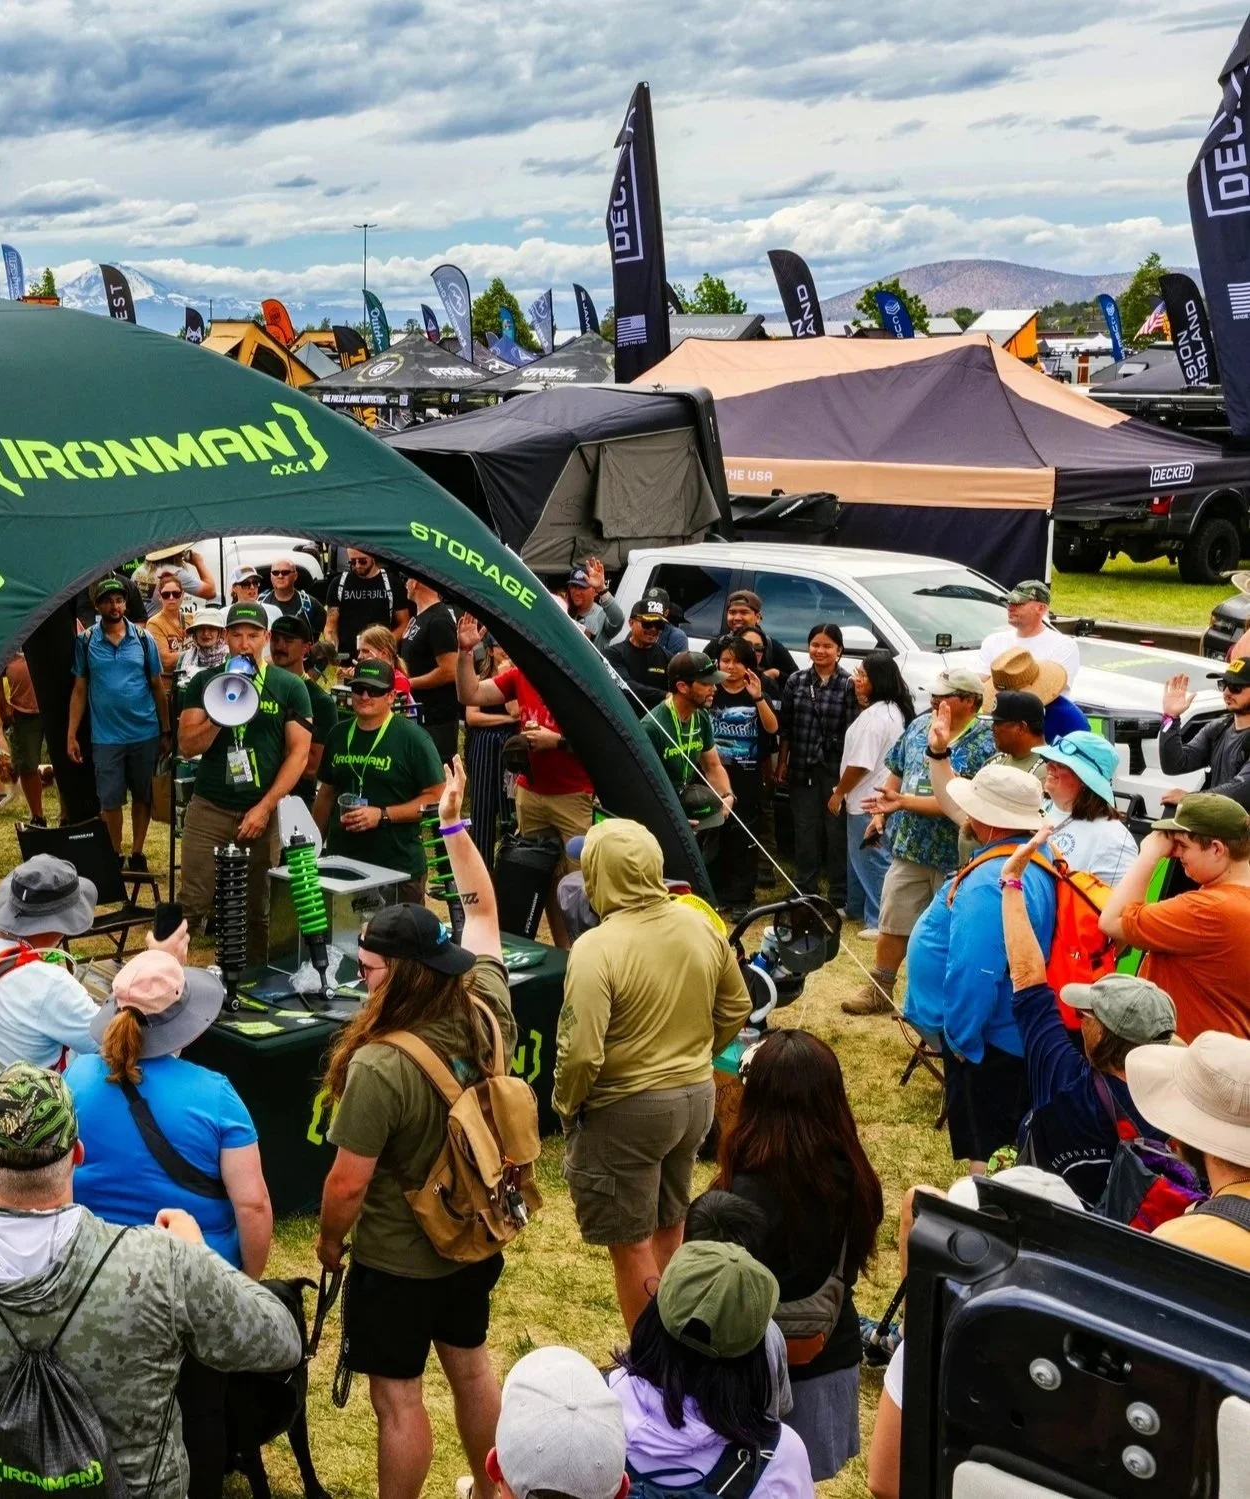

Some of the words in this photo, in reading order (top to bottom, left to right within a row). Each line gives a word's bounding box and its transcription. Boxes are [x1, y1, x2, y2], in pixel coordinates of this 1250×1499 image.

[610, 176, 630, 252] DEC
[671, 326, 730, 338] RONMAN
[1185, 300, 1210, 388] ERLAND
[269, 460, 309, 478] 4X4
[747, 470, 773, 481] USA
[1152, 465, 1192, 482] DECKED
[409, 521, 537, 610] STORAGE
[1051, 1148, 1107, 1170] ELEBRATE
[2, 1463, 94, 1491] IRONMAN
